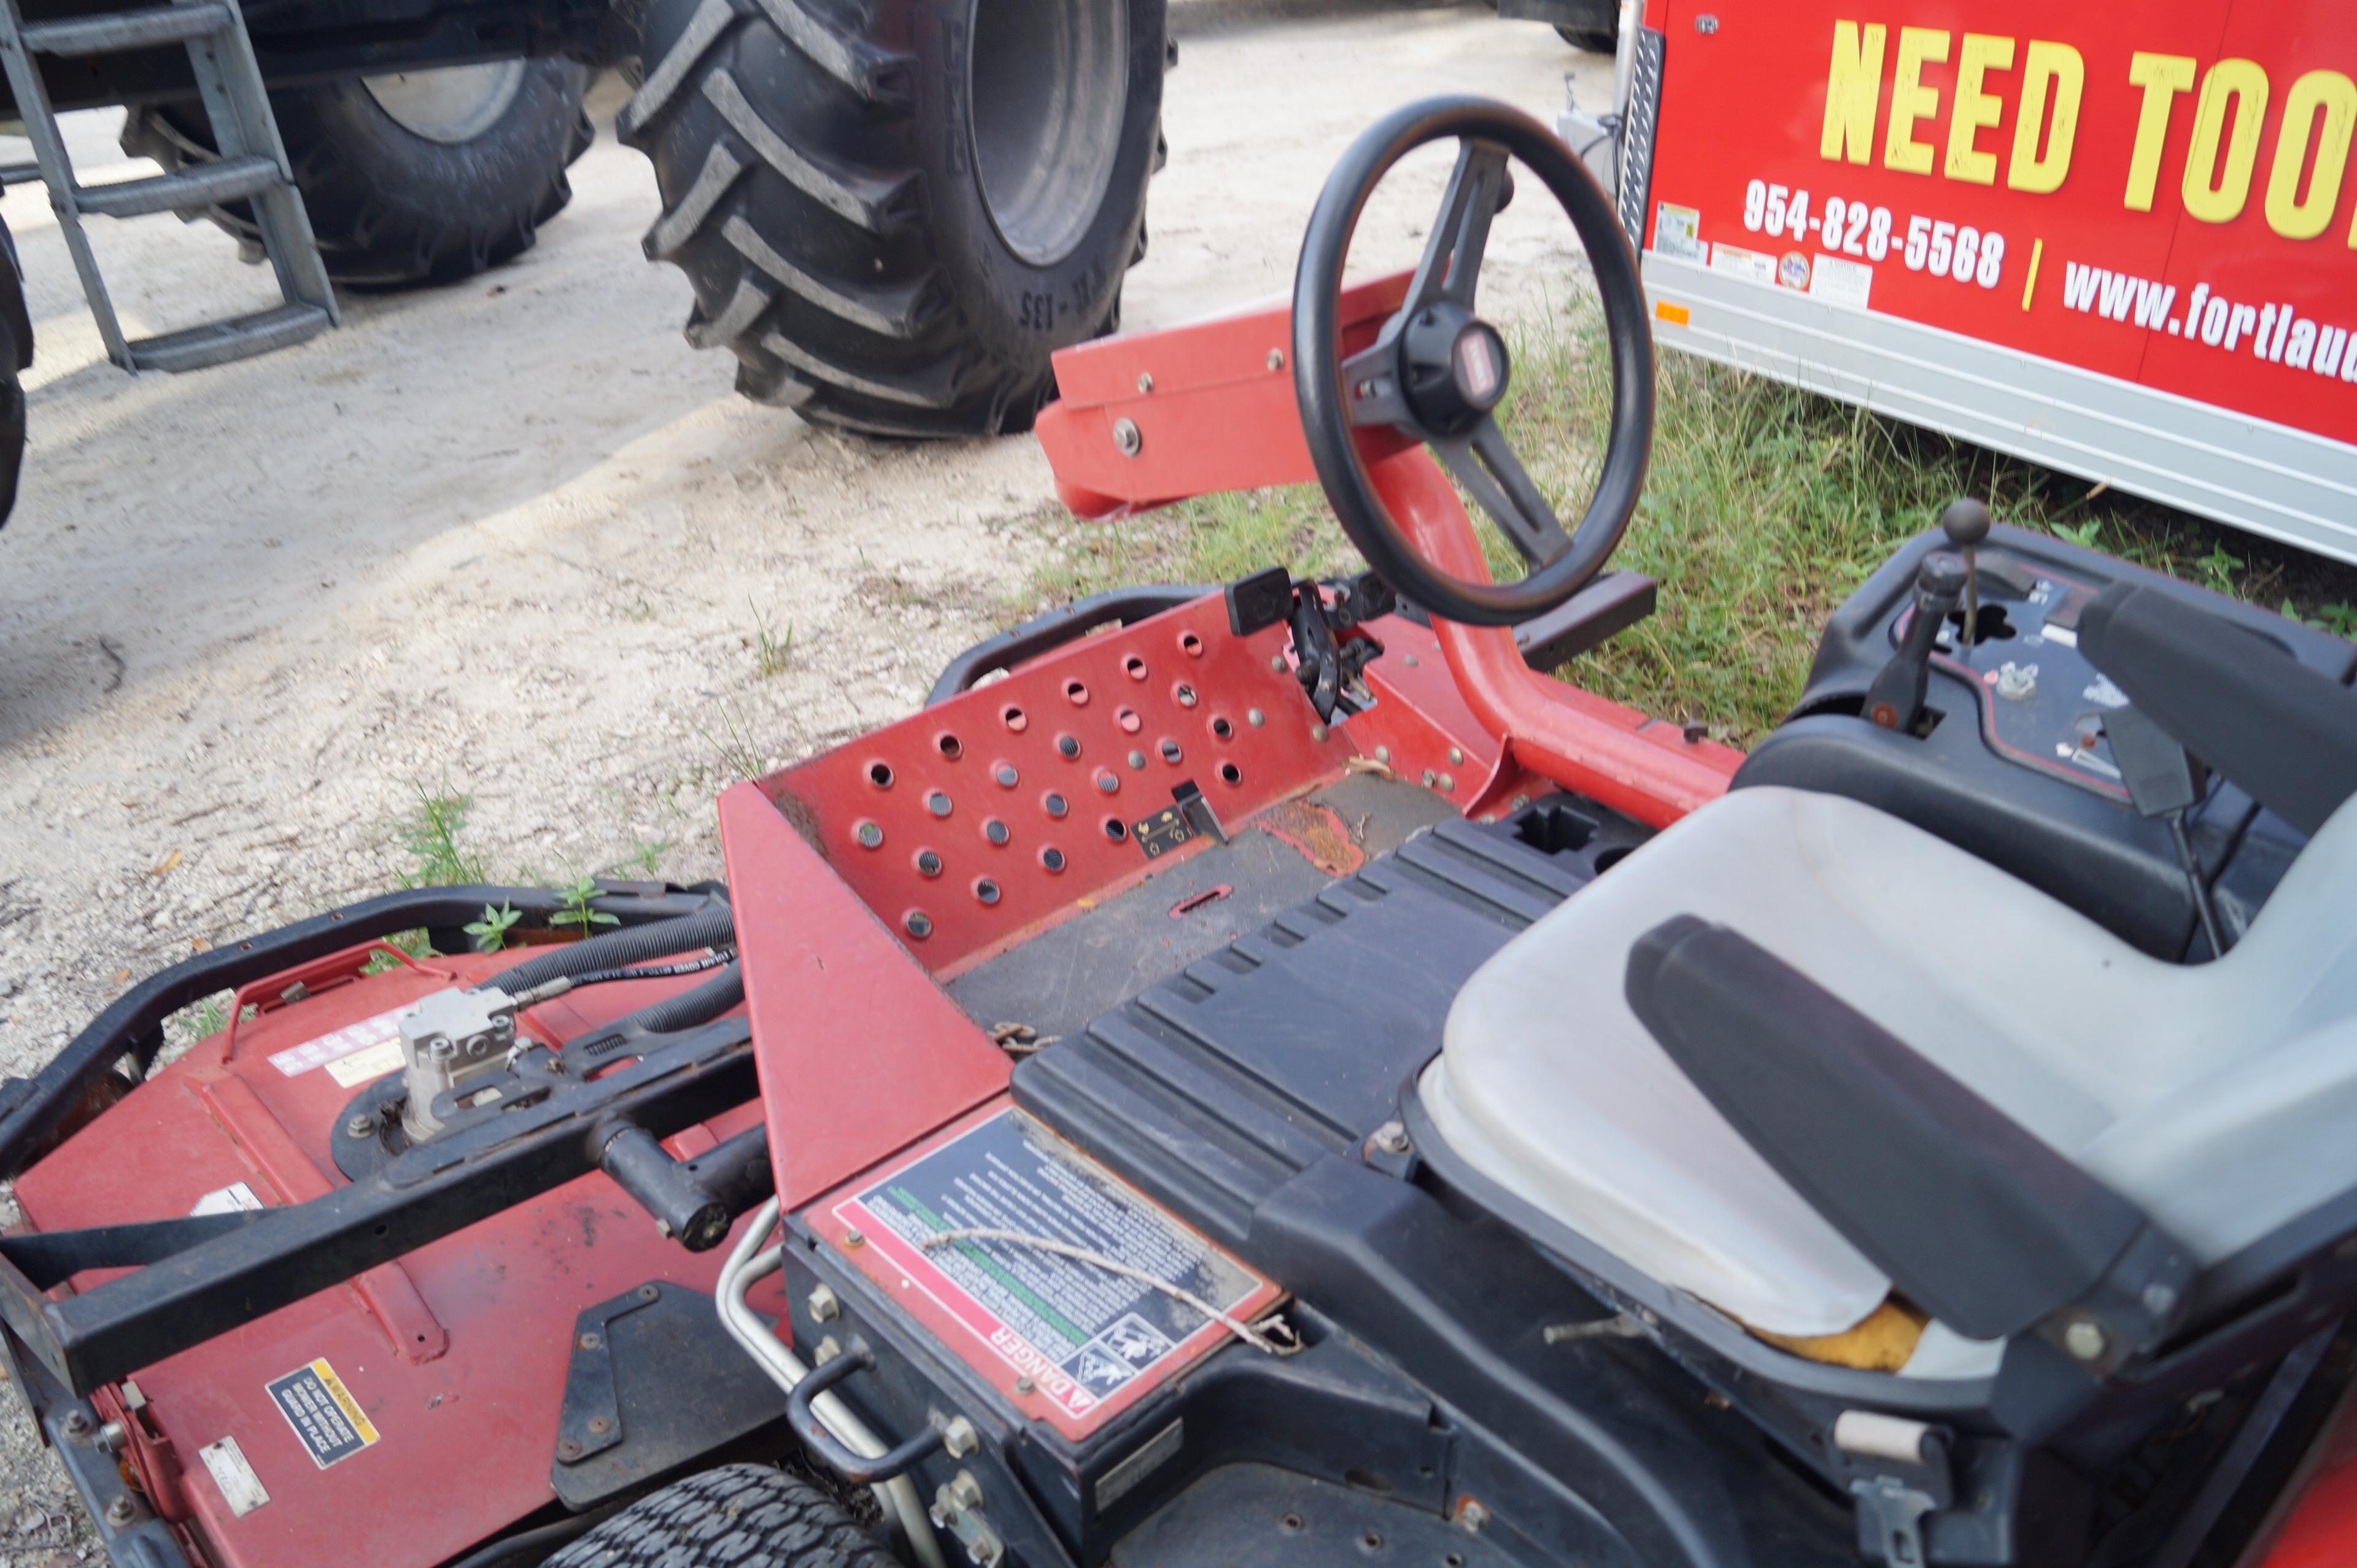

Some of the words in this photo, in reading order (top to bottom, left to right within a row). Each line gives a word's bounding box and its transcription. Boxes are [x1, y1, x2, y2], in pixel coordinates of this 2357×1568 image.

[1821, 20, 2084, 195] NEED
[2124, 51, 2357, 250] TOO
[1743, 179, 2006, 290] 954-828-5568
[988, 1325, 1074, 1396] DANGER
[279, 1388, 306, 1418] GUARD
[290, 1381, 319, 1413] MOWER
[311, 1410, 343, 1448] WITHOUT
[299, 1415, 312, 1427] IN
[302, 1375, 317, 1391] DO
[311, 1388, 330, 1407] NOT
[322, 1404, 355, 1443] OPERATE
[331, 1383, 366, 1426] WARNING
[305, 1424, 331, 1454] PLACE
